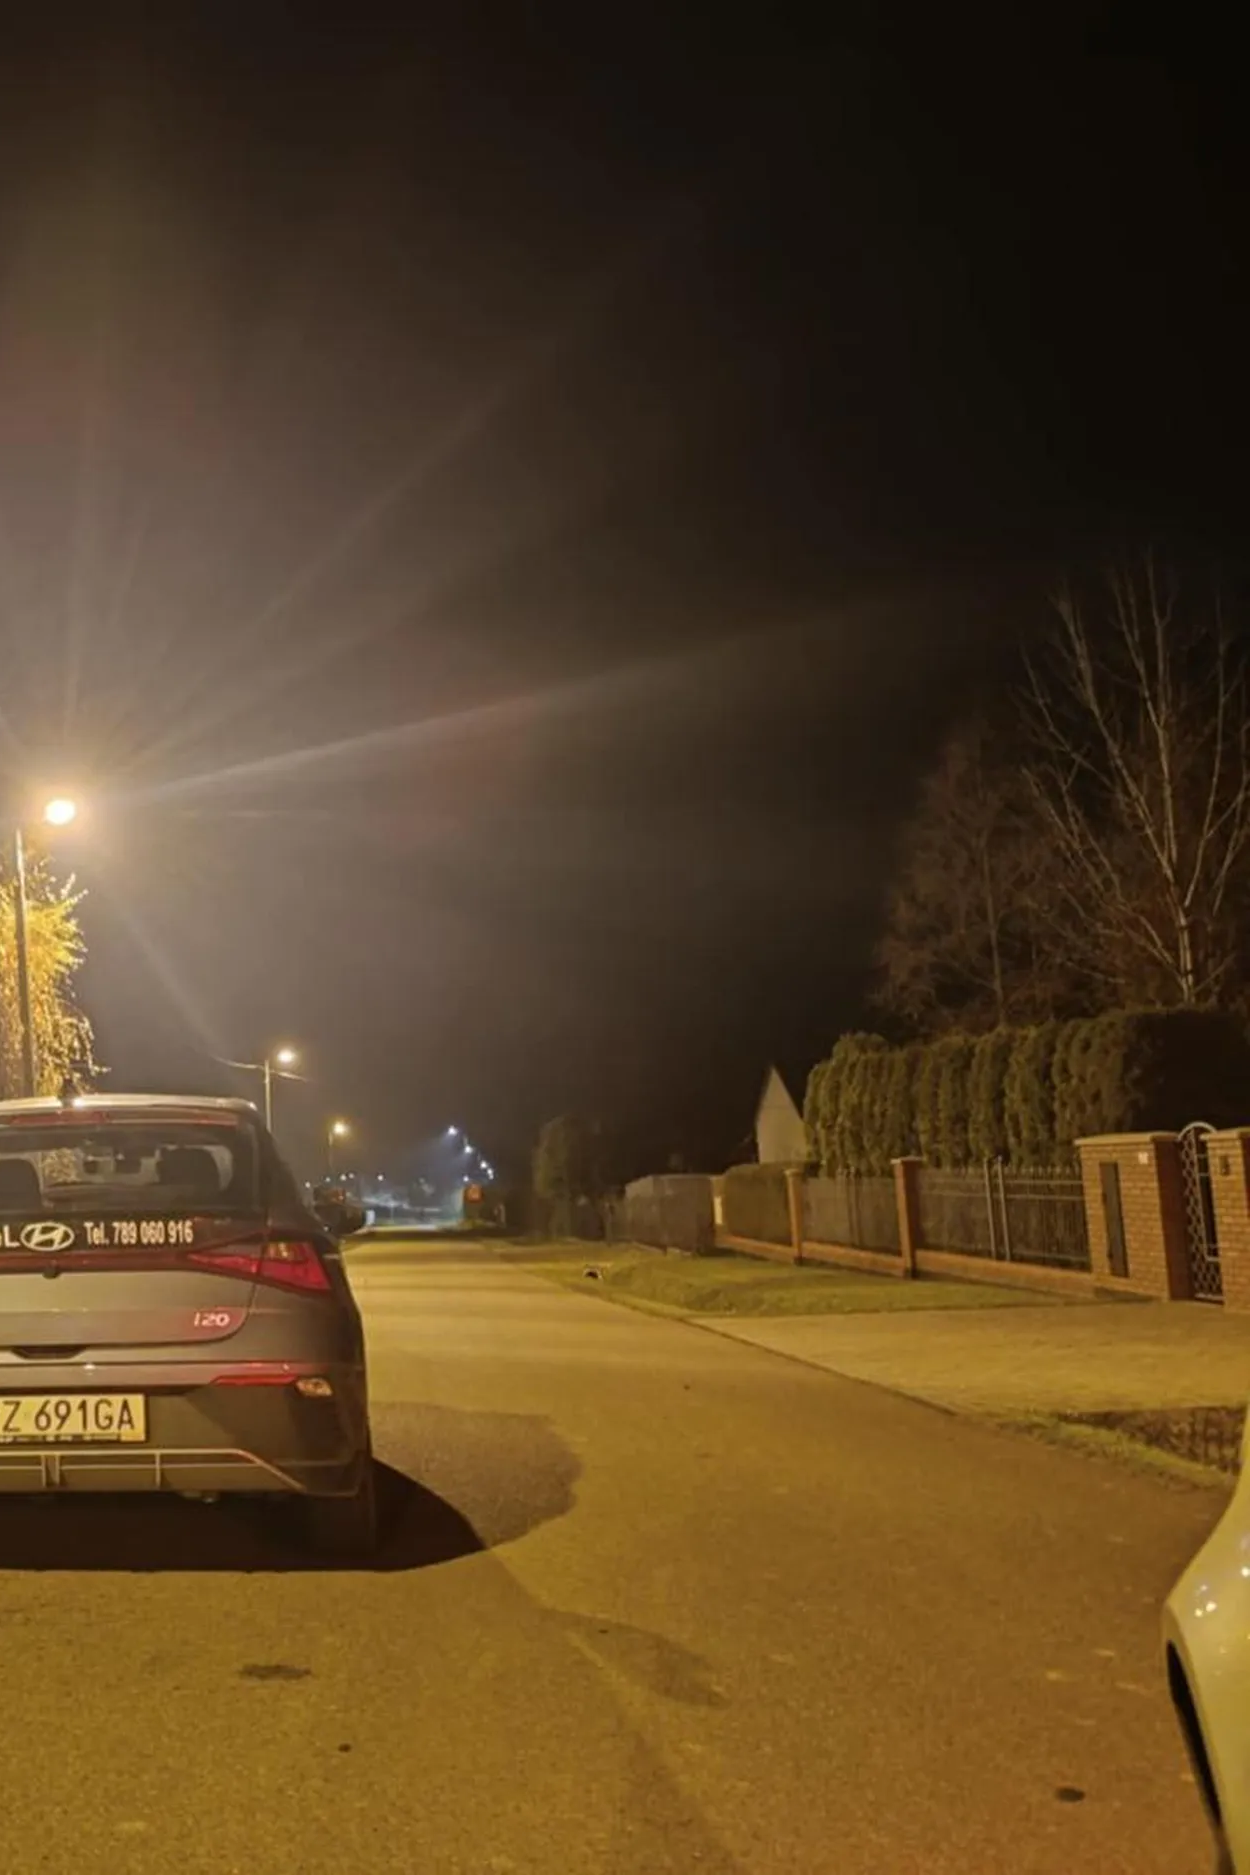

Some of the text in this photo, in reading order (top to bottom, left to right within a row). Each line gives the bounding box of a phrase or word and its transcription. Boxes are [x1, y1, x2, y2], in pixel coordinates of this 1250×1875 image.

[83, 1221, 110, 1245] Tel.
[112, 1221, 137, 1244] 789
[167, 1220, 193, 1243] 916
[34, 1399, 135, 1432] 691GA
